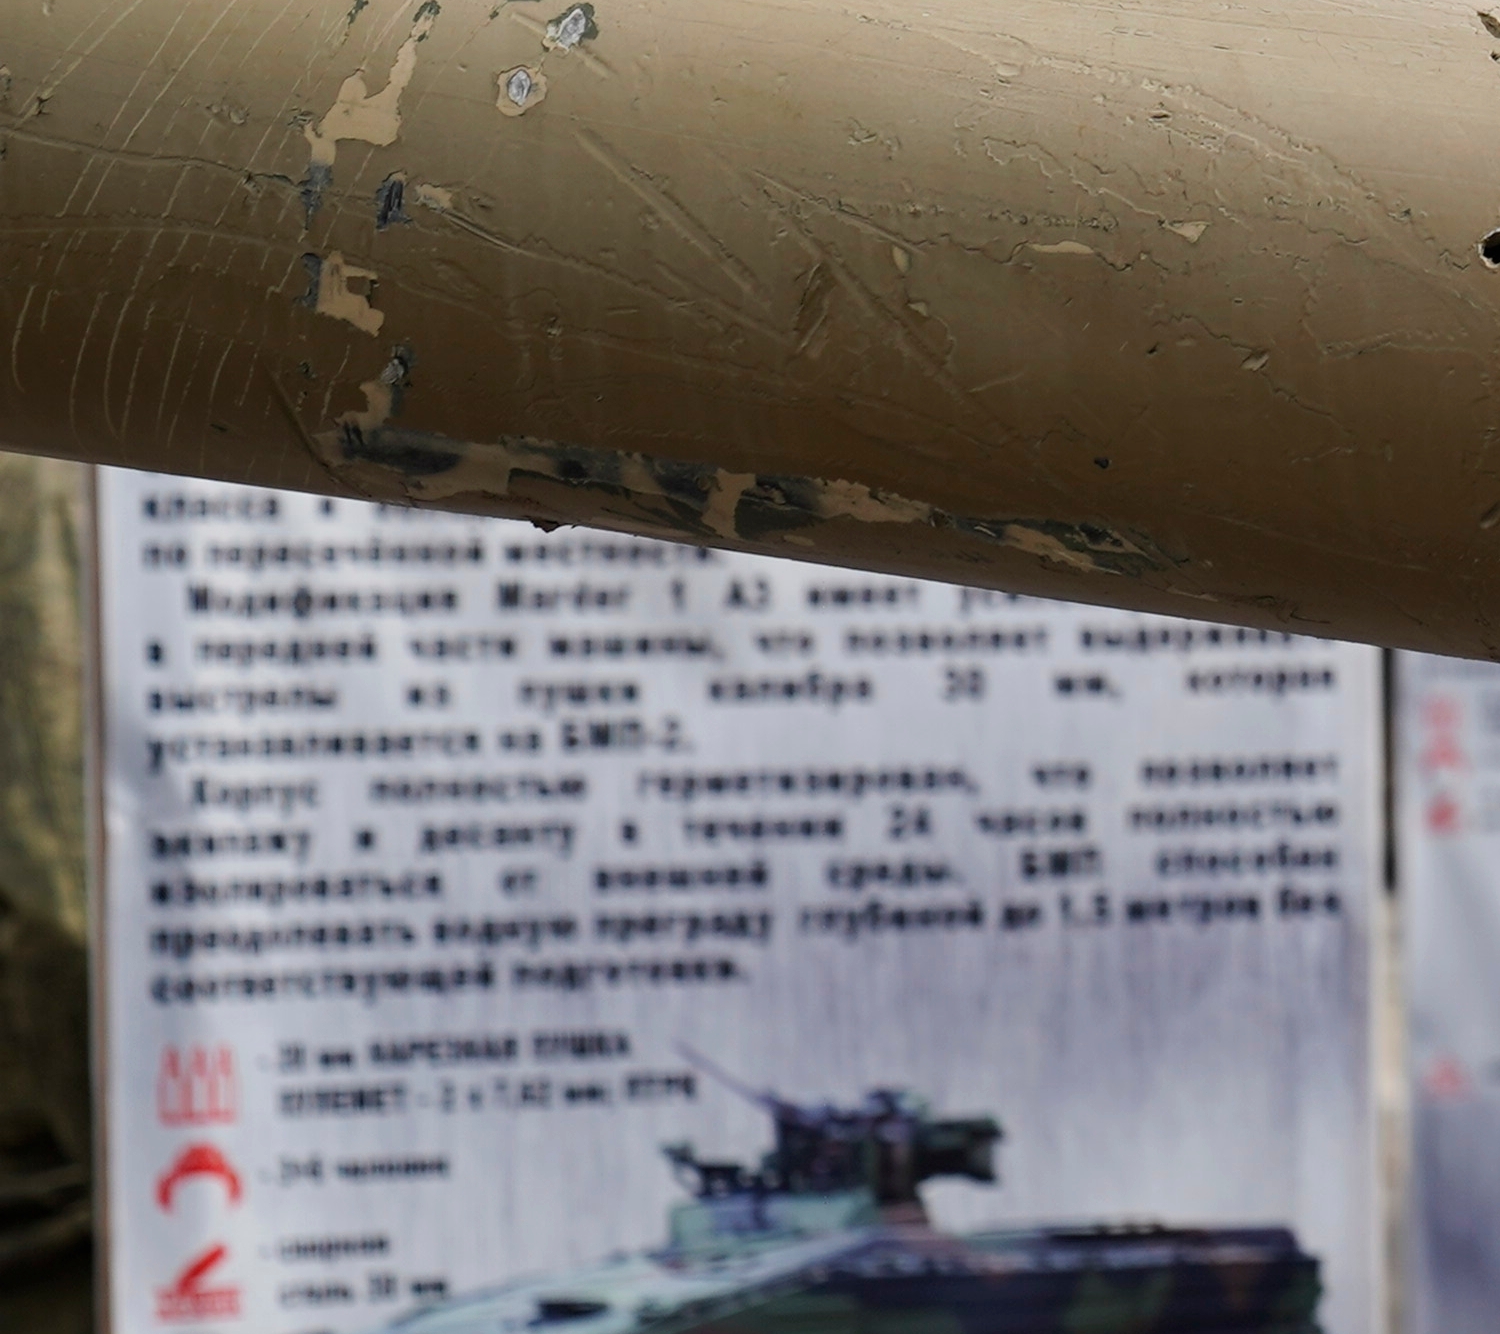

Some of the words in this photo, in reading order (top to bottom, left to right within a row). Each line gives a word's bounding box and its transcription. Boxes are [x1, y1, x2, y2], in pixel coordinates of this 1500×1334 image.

[143, 539, 187, 567] по
[184, 582, 462, 624] Модификация
[494, 579, 632, 615] Marder
[194, 631, 381, 670] передней
[407, 632, 520, 664] части
[752, 628, 816, 657] что
[842, 624, 1049, 657] позволяет
[144, 682, 341, 718] выстрелы
[403, 681, 452, 710] из
[516, 677, 643, 714] пушки
[704, 666, 876, 709] калибра
[1183, 664, 1338, 701] которая
[147, 727, 482, 770] устанавливается
[498, 728, 543, 756] на
[189, 777, 322, 817] Корпус
[367, 772, 590, 807] полностью
[1029, 760, 1095, 791] что
[1138, 751, 1340, 788] позволяет
[416, 817, 579, 860] десанту
[972, 805, 1089, 839] часов
[1125, 798, 1342, 835] полностью
[149, 869, 442, 907] изолироваться
[591, 853, 772, 896] внешней
[1017, 842, 1106, 885] БМП
[149, 957, 496, 1005] соответствующей
